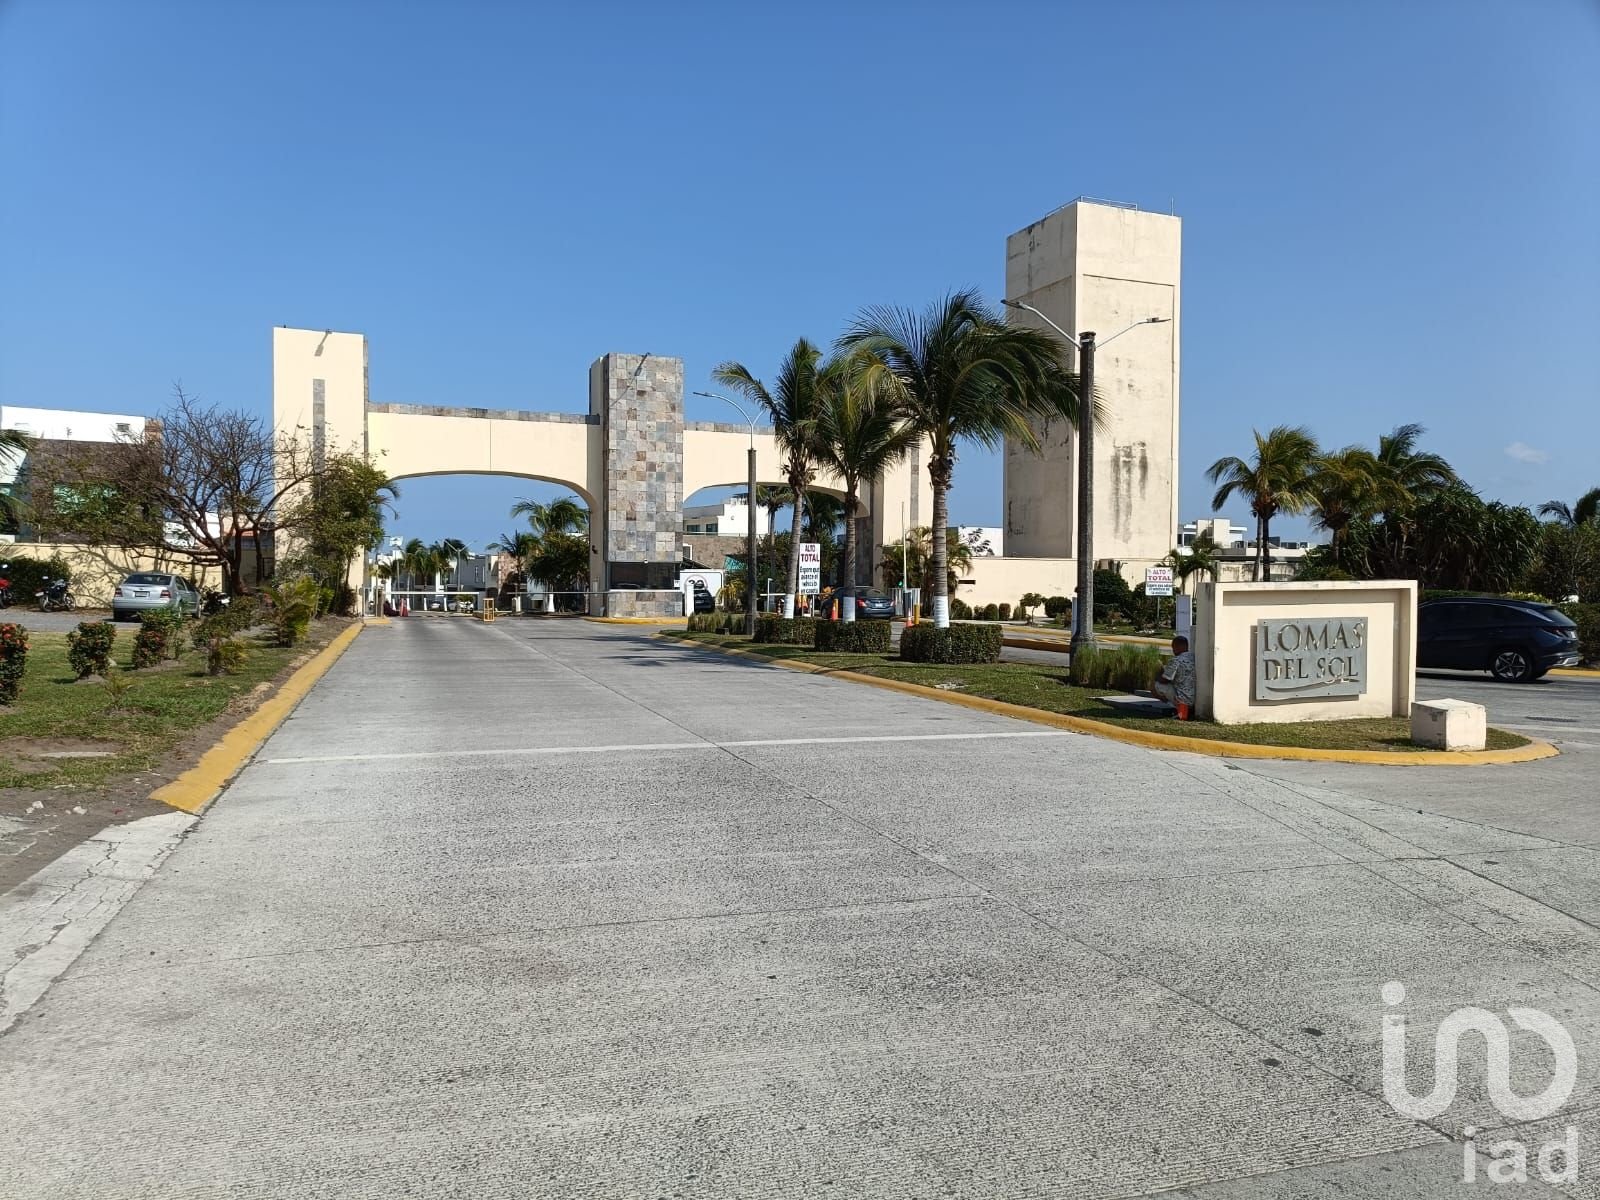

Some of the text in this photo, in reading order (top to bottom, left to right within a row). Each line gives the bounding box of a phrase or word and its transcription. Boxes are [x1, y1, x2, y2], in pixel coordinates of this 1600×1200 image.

[805, 544, 815, 552] ALTO
[800, 553, 820, 562] TOTAL
[1263, 621, 1364, 652] LOMAS
[1263, 656, 1359, 681] DEL SOL
